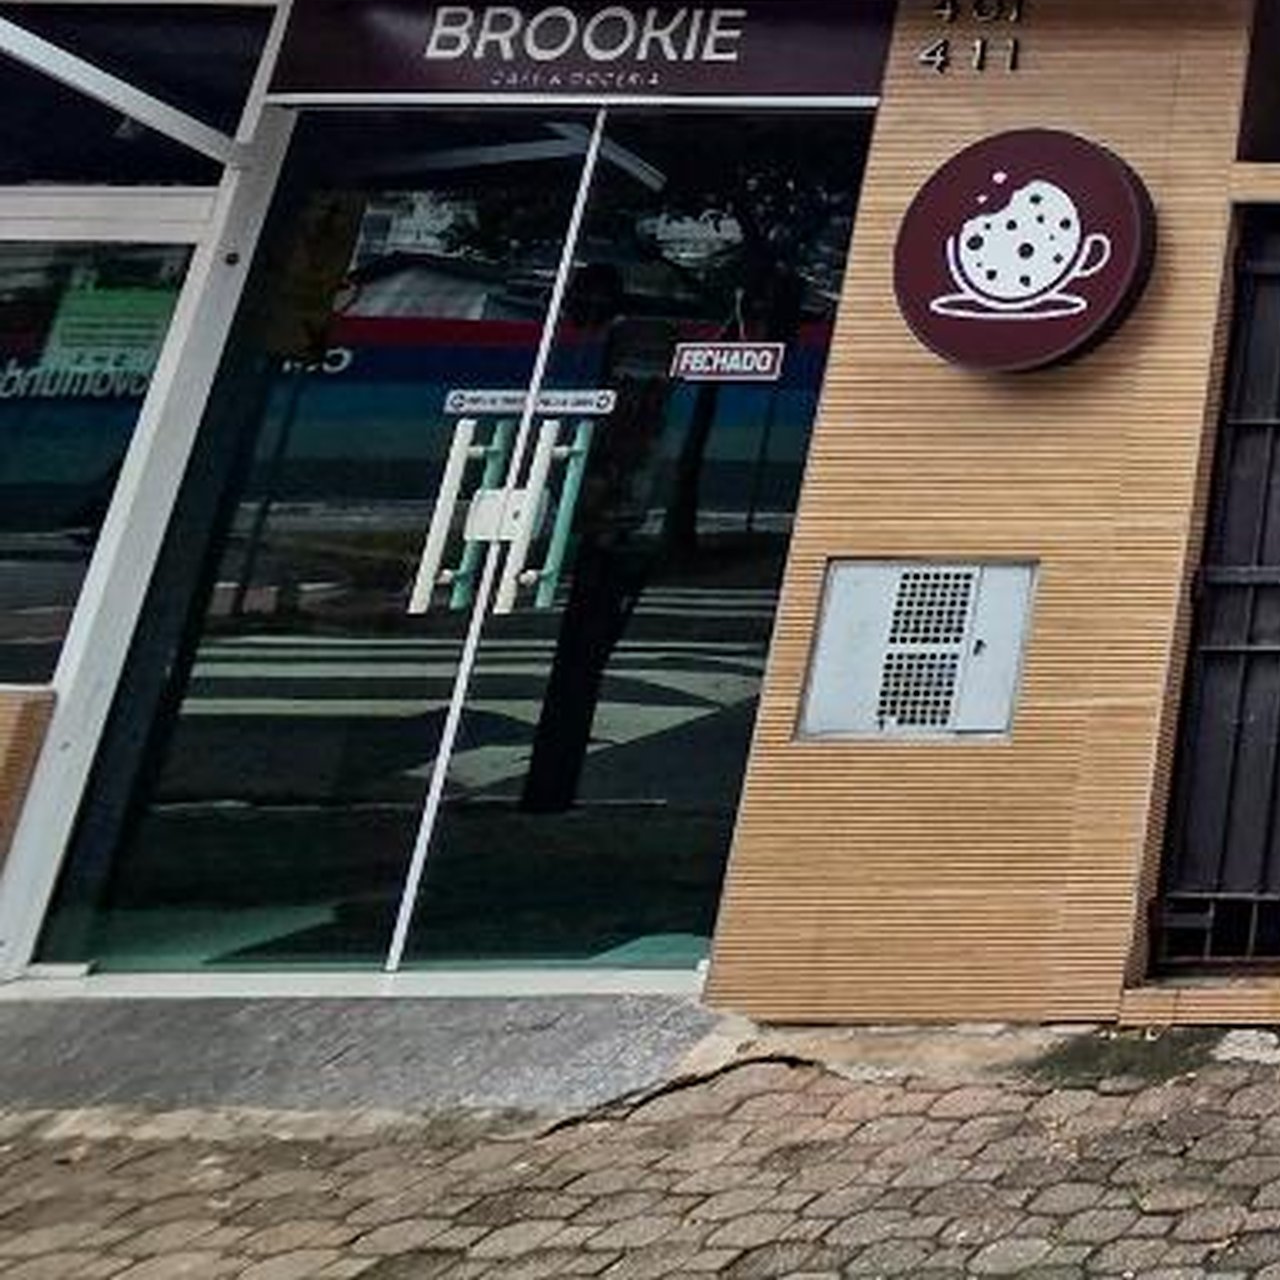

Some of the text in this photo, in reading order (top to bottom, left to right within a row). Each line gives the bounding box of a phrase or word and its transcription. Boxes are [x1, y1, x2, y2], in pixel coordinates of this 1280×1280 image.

[423, 5, 748, 62] BROOKIE
[916, 37, 1020, 75] 411
[679, 348, 774, 372] FECHADO
